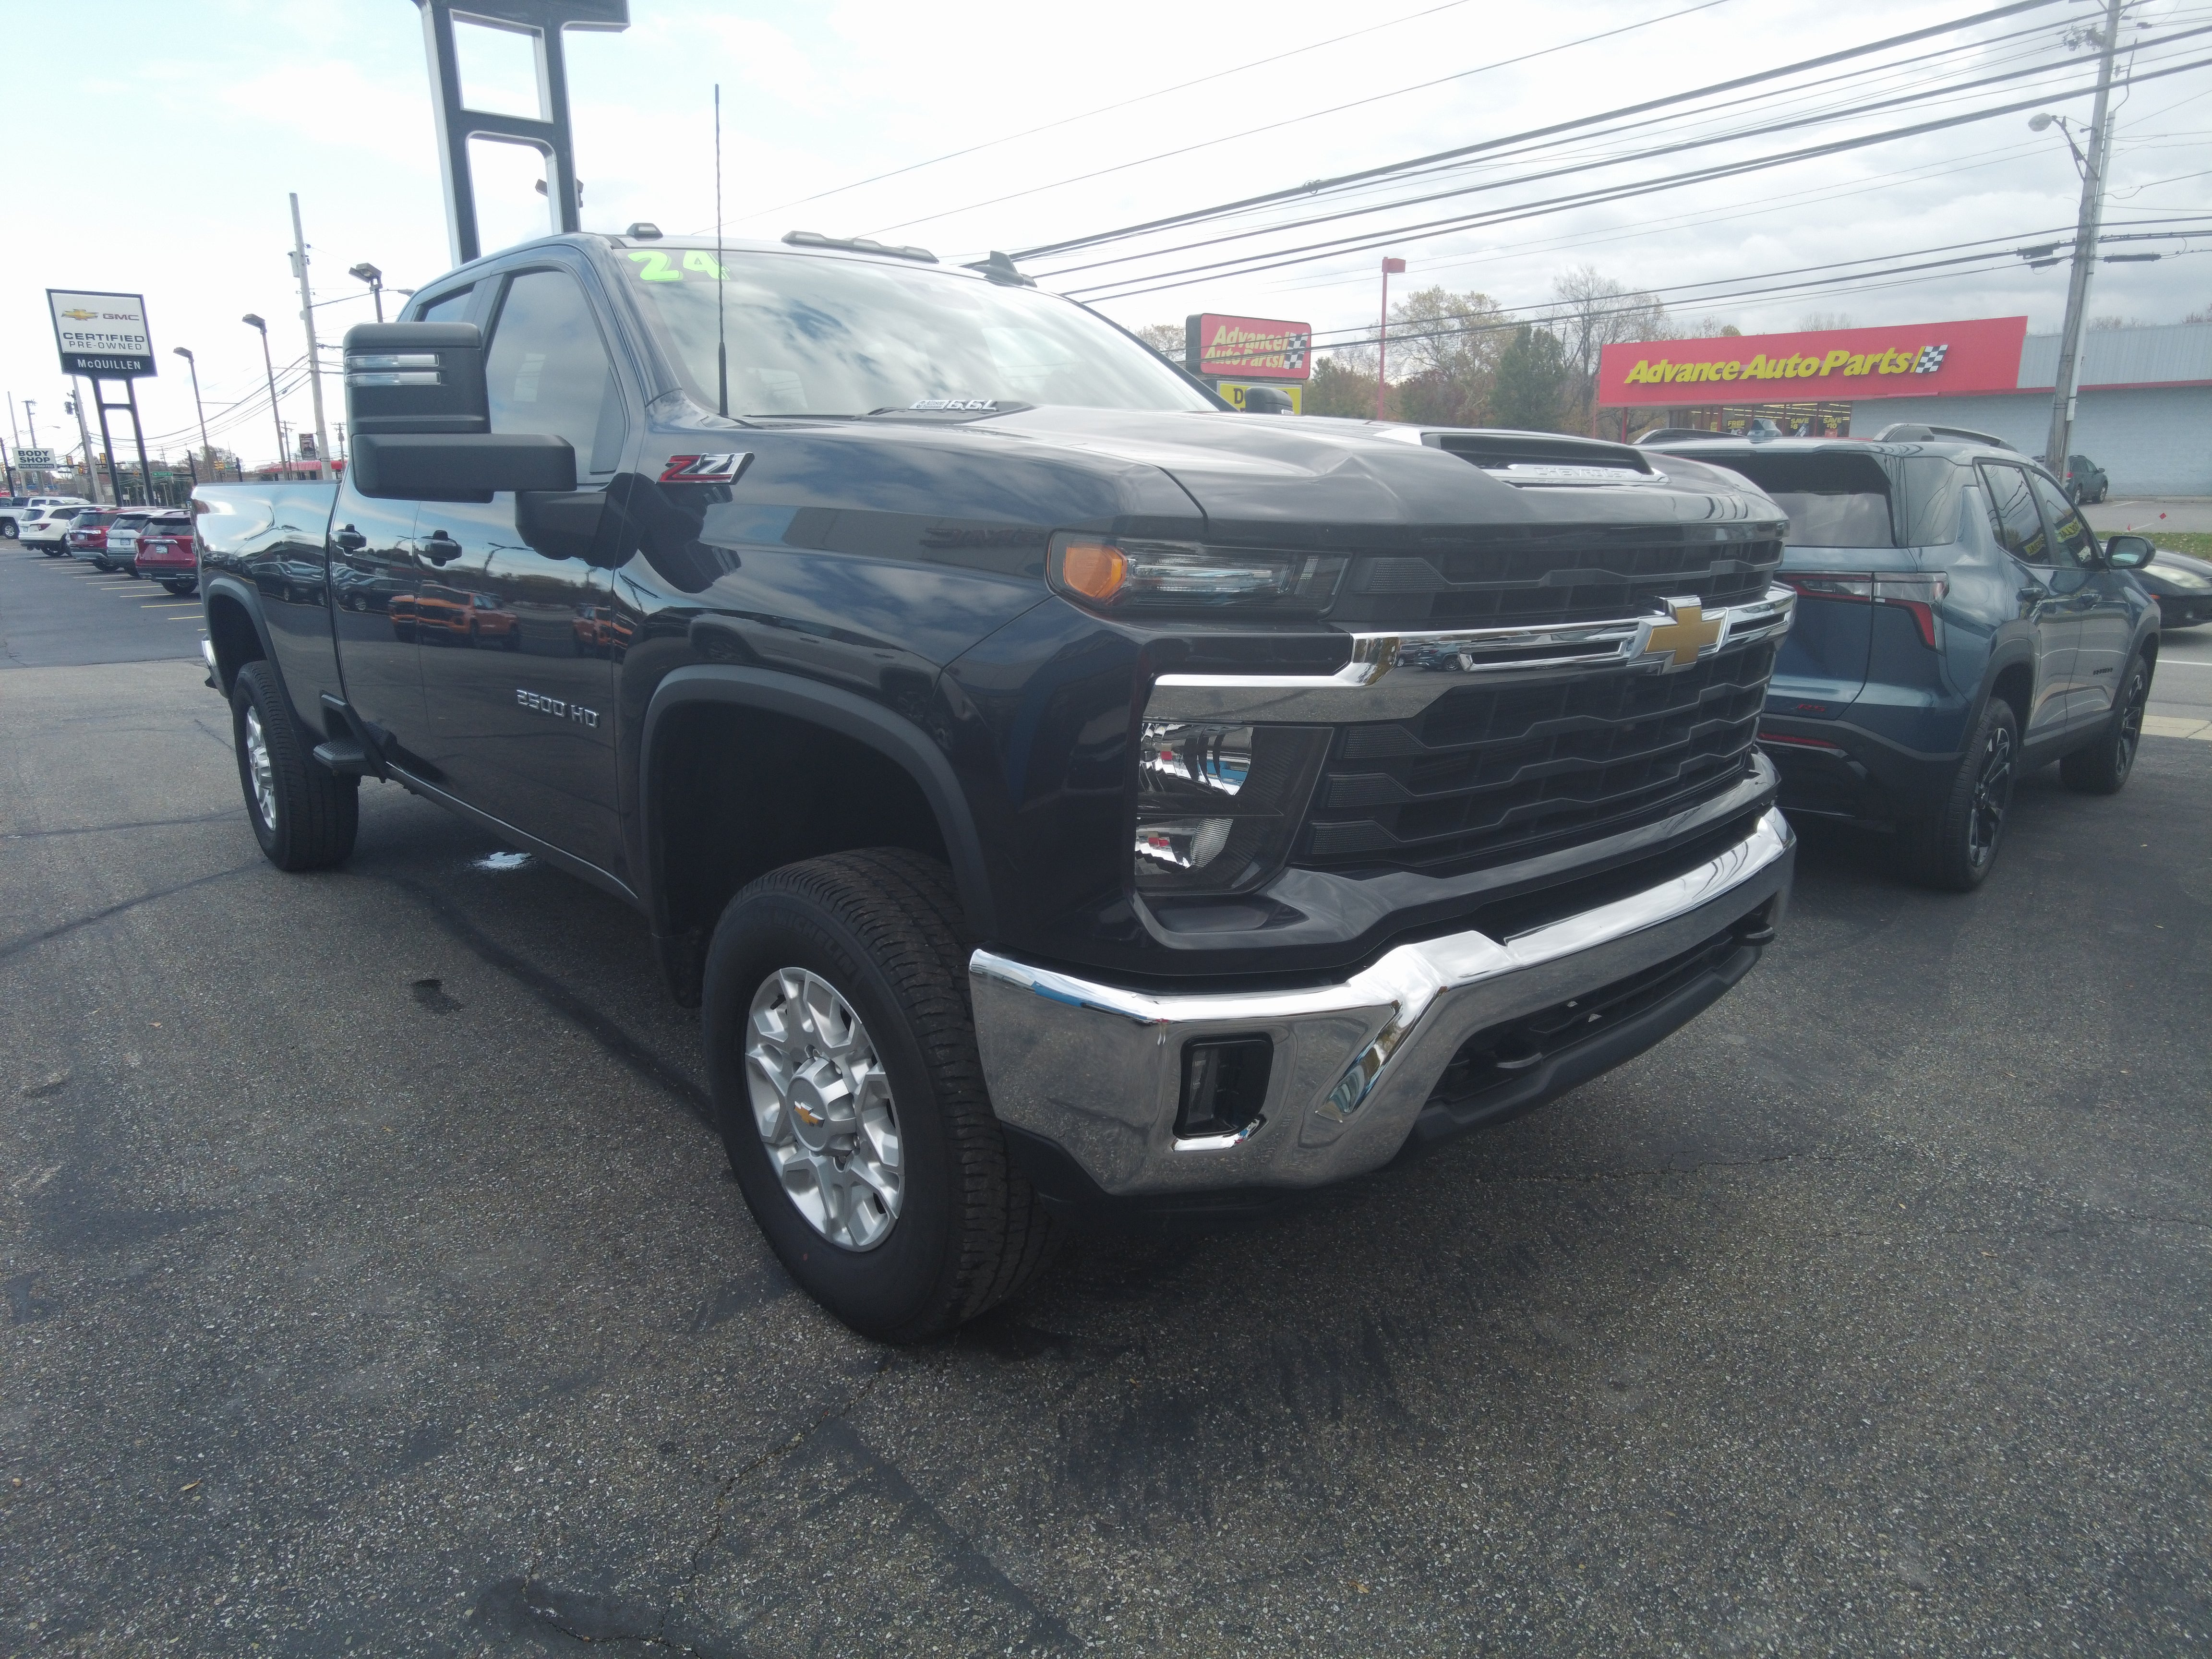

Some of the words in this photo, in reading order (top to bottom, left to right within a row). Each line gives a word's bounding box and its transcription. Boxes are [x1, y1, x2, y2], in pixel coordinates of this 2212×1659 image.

[627, 250, 730, 281] 24
[103, 313, 140, 321] GMC
[63, 332, 144, 343] CERTIFIED
[69, 341, 142, 350] PRE-OWNED
[1210, 325, 1283, 351] Advance
[77, 359, 141, 370] McQUILLEN
[1202, 347, 1241, 365] Auto
[1241, 349, 1281, 368] Parts
[1624, 359, 1741, 384] Advance
[1739, 353, 1820, 380] Auto
[1819, 347, 1912, 377] Parts
[656, 452, 755, 485] Z71
[1534, 467, 1629, 479] CHEVROLET
[516, 689, 567, 718] 2500
[570, 704, 600, 728] HD
